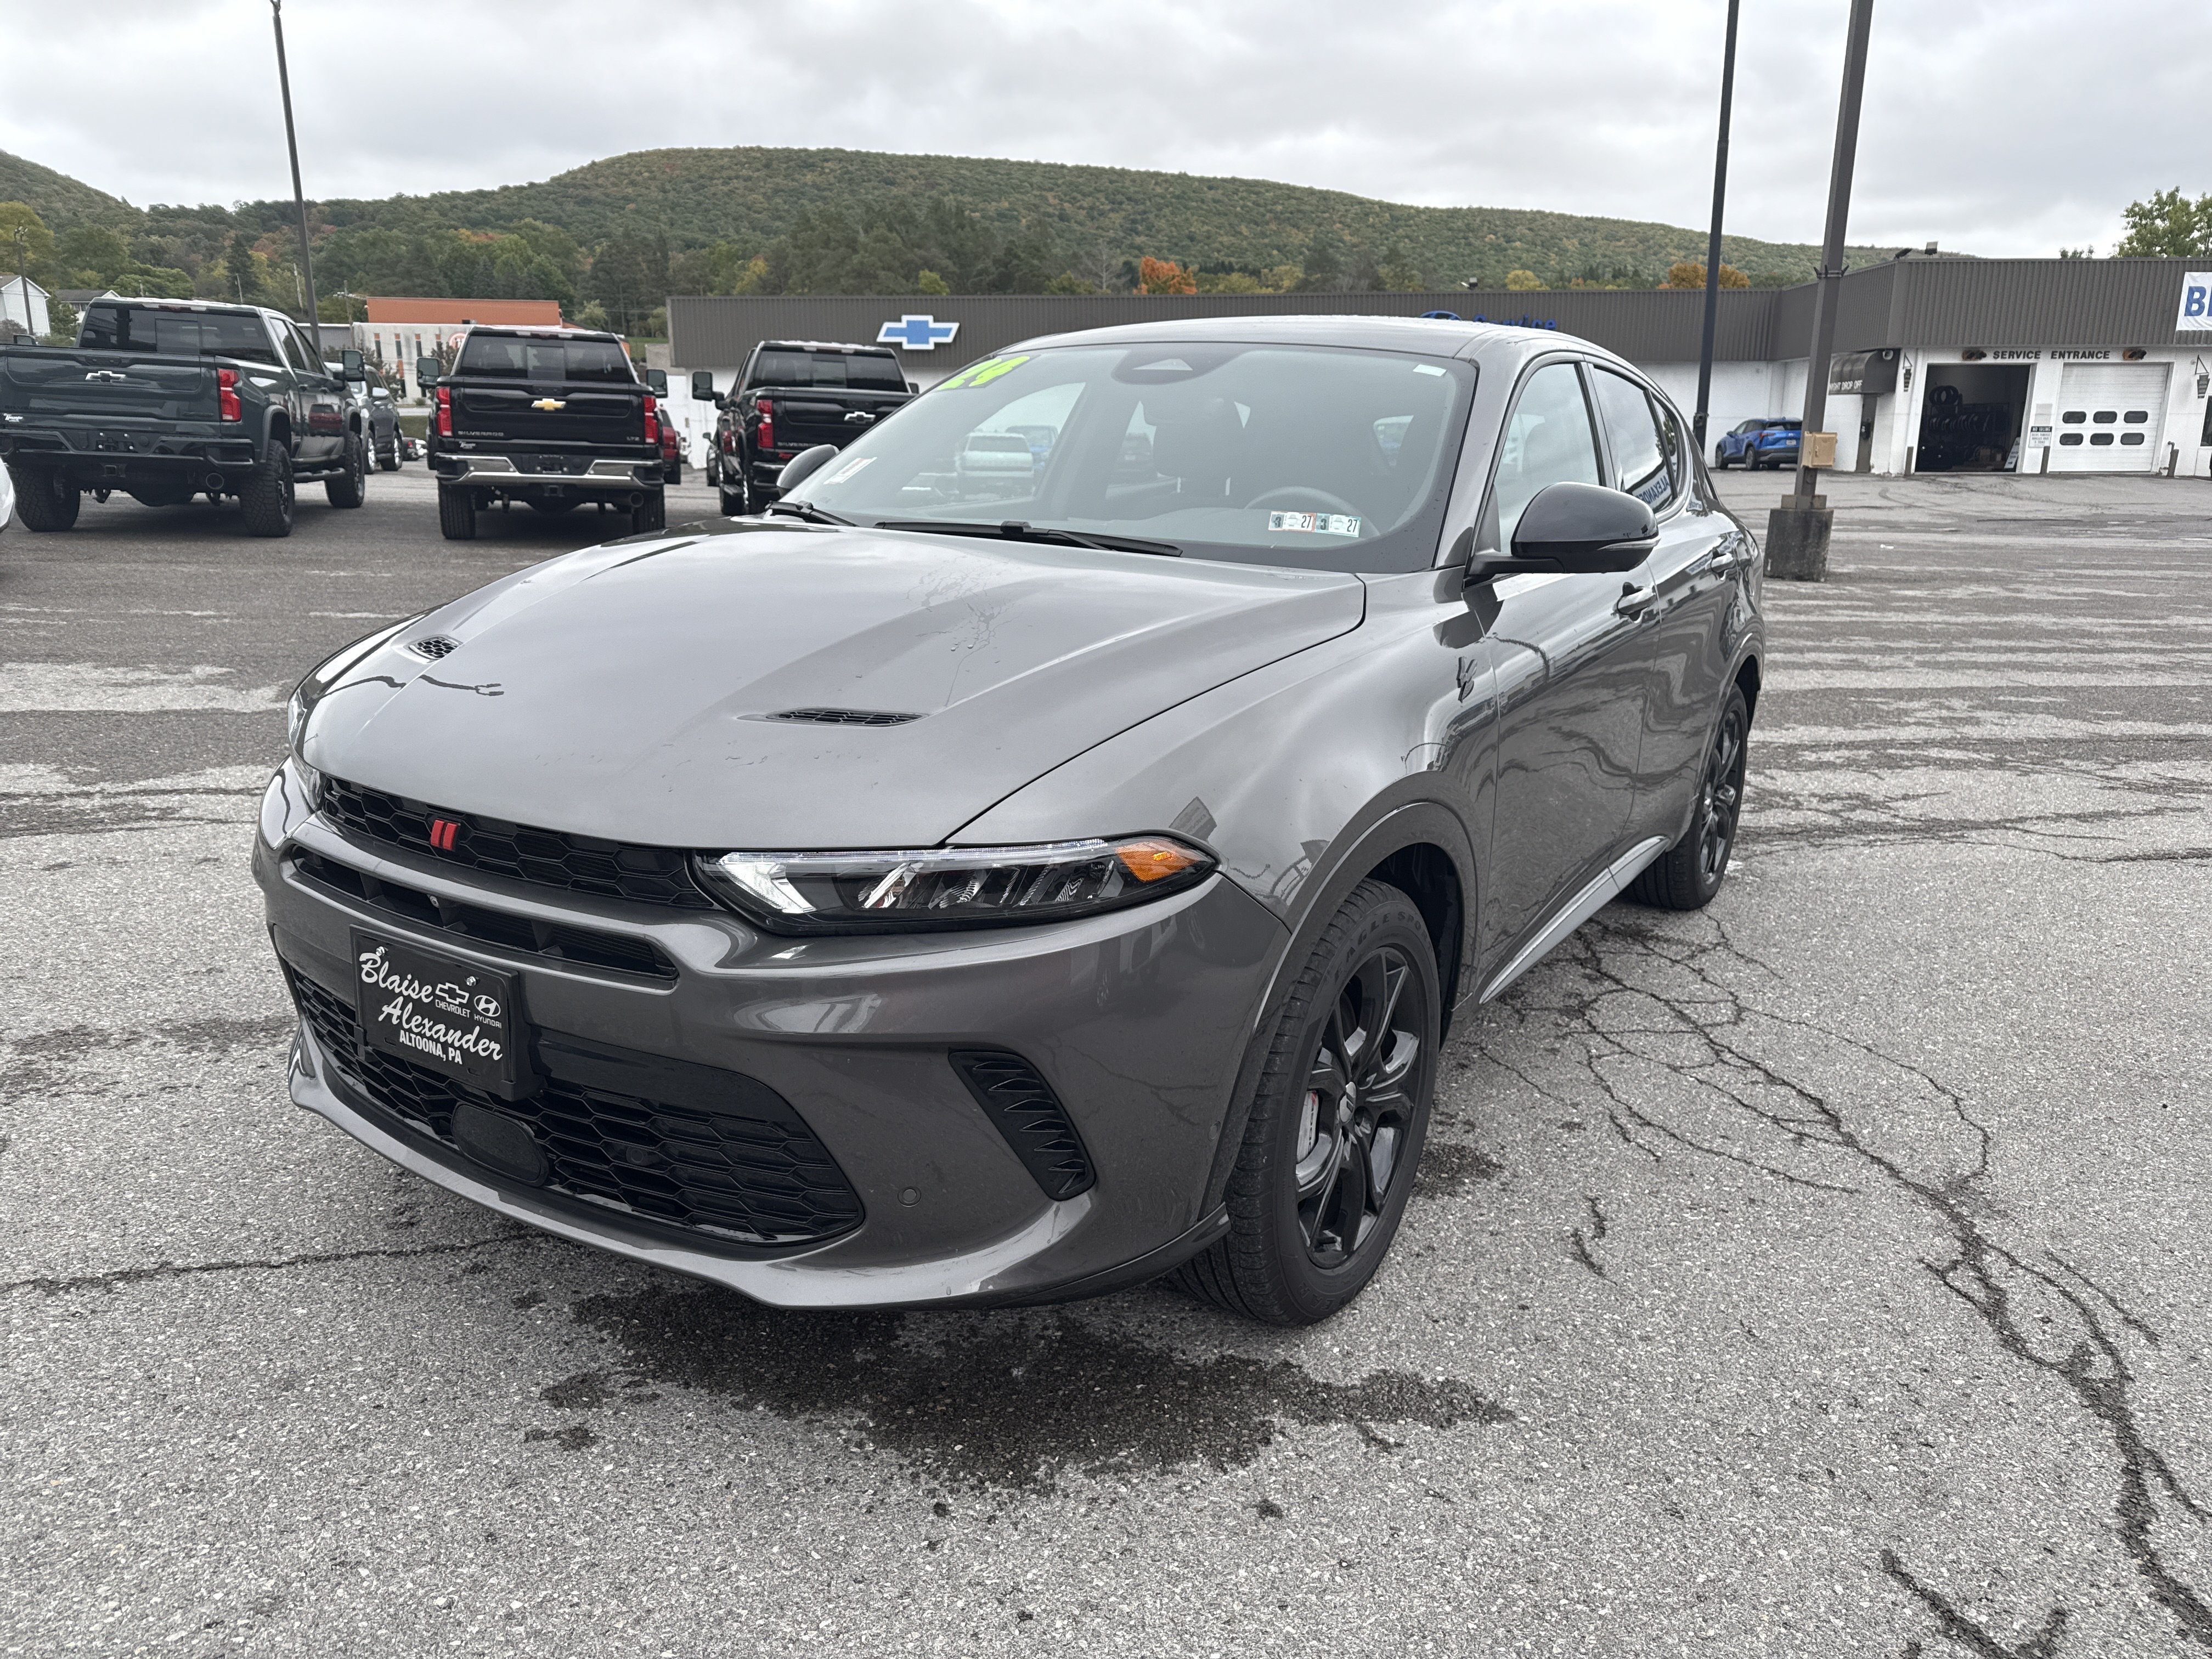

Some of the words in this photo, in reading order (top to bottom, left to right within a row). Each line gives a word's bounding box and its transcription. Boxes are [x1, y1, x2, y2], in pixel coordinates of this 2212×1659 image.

[2184, 286, 2212, 317] B
[1993, 350, 2041, 360] SERVICE
[2050, 350, 2111, 360] ENTRANCE
[1274, 516, 1282, 528] 3
[1301, 515, 1312, 529] 27
[1320, 518, 1327, 531] 3
[1346, 518, 1358, 533] 27
[1334, 912, 1391, 985] EAGLE
[359, 952, 434, 1003] Blaise
[435, 999, 471, 1018] CHEVROLET
[473, 1013, 502, 1029] HYUNDAI
[378, 996, 503, 1060] Alexander
[399, 1029, 446, 1062] ALTOONA,
[448, 1047, 463, 1065] PA
